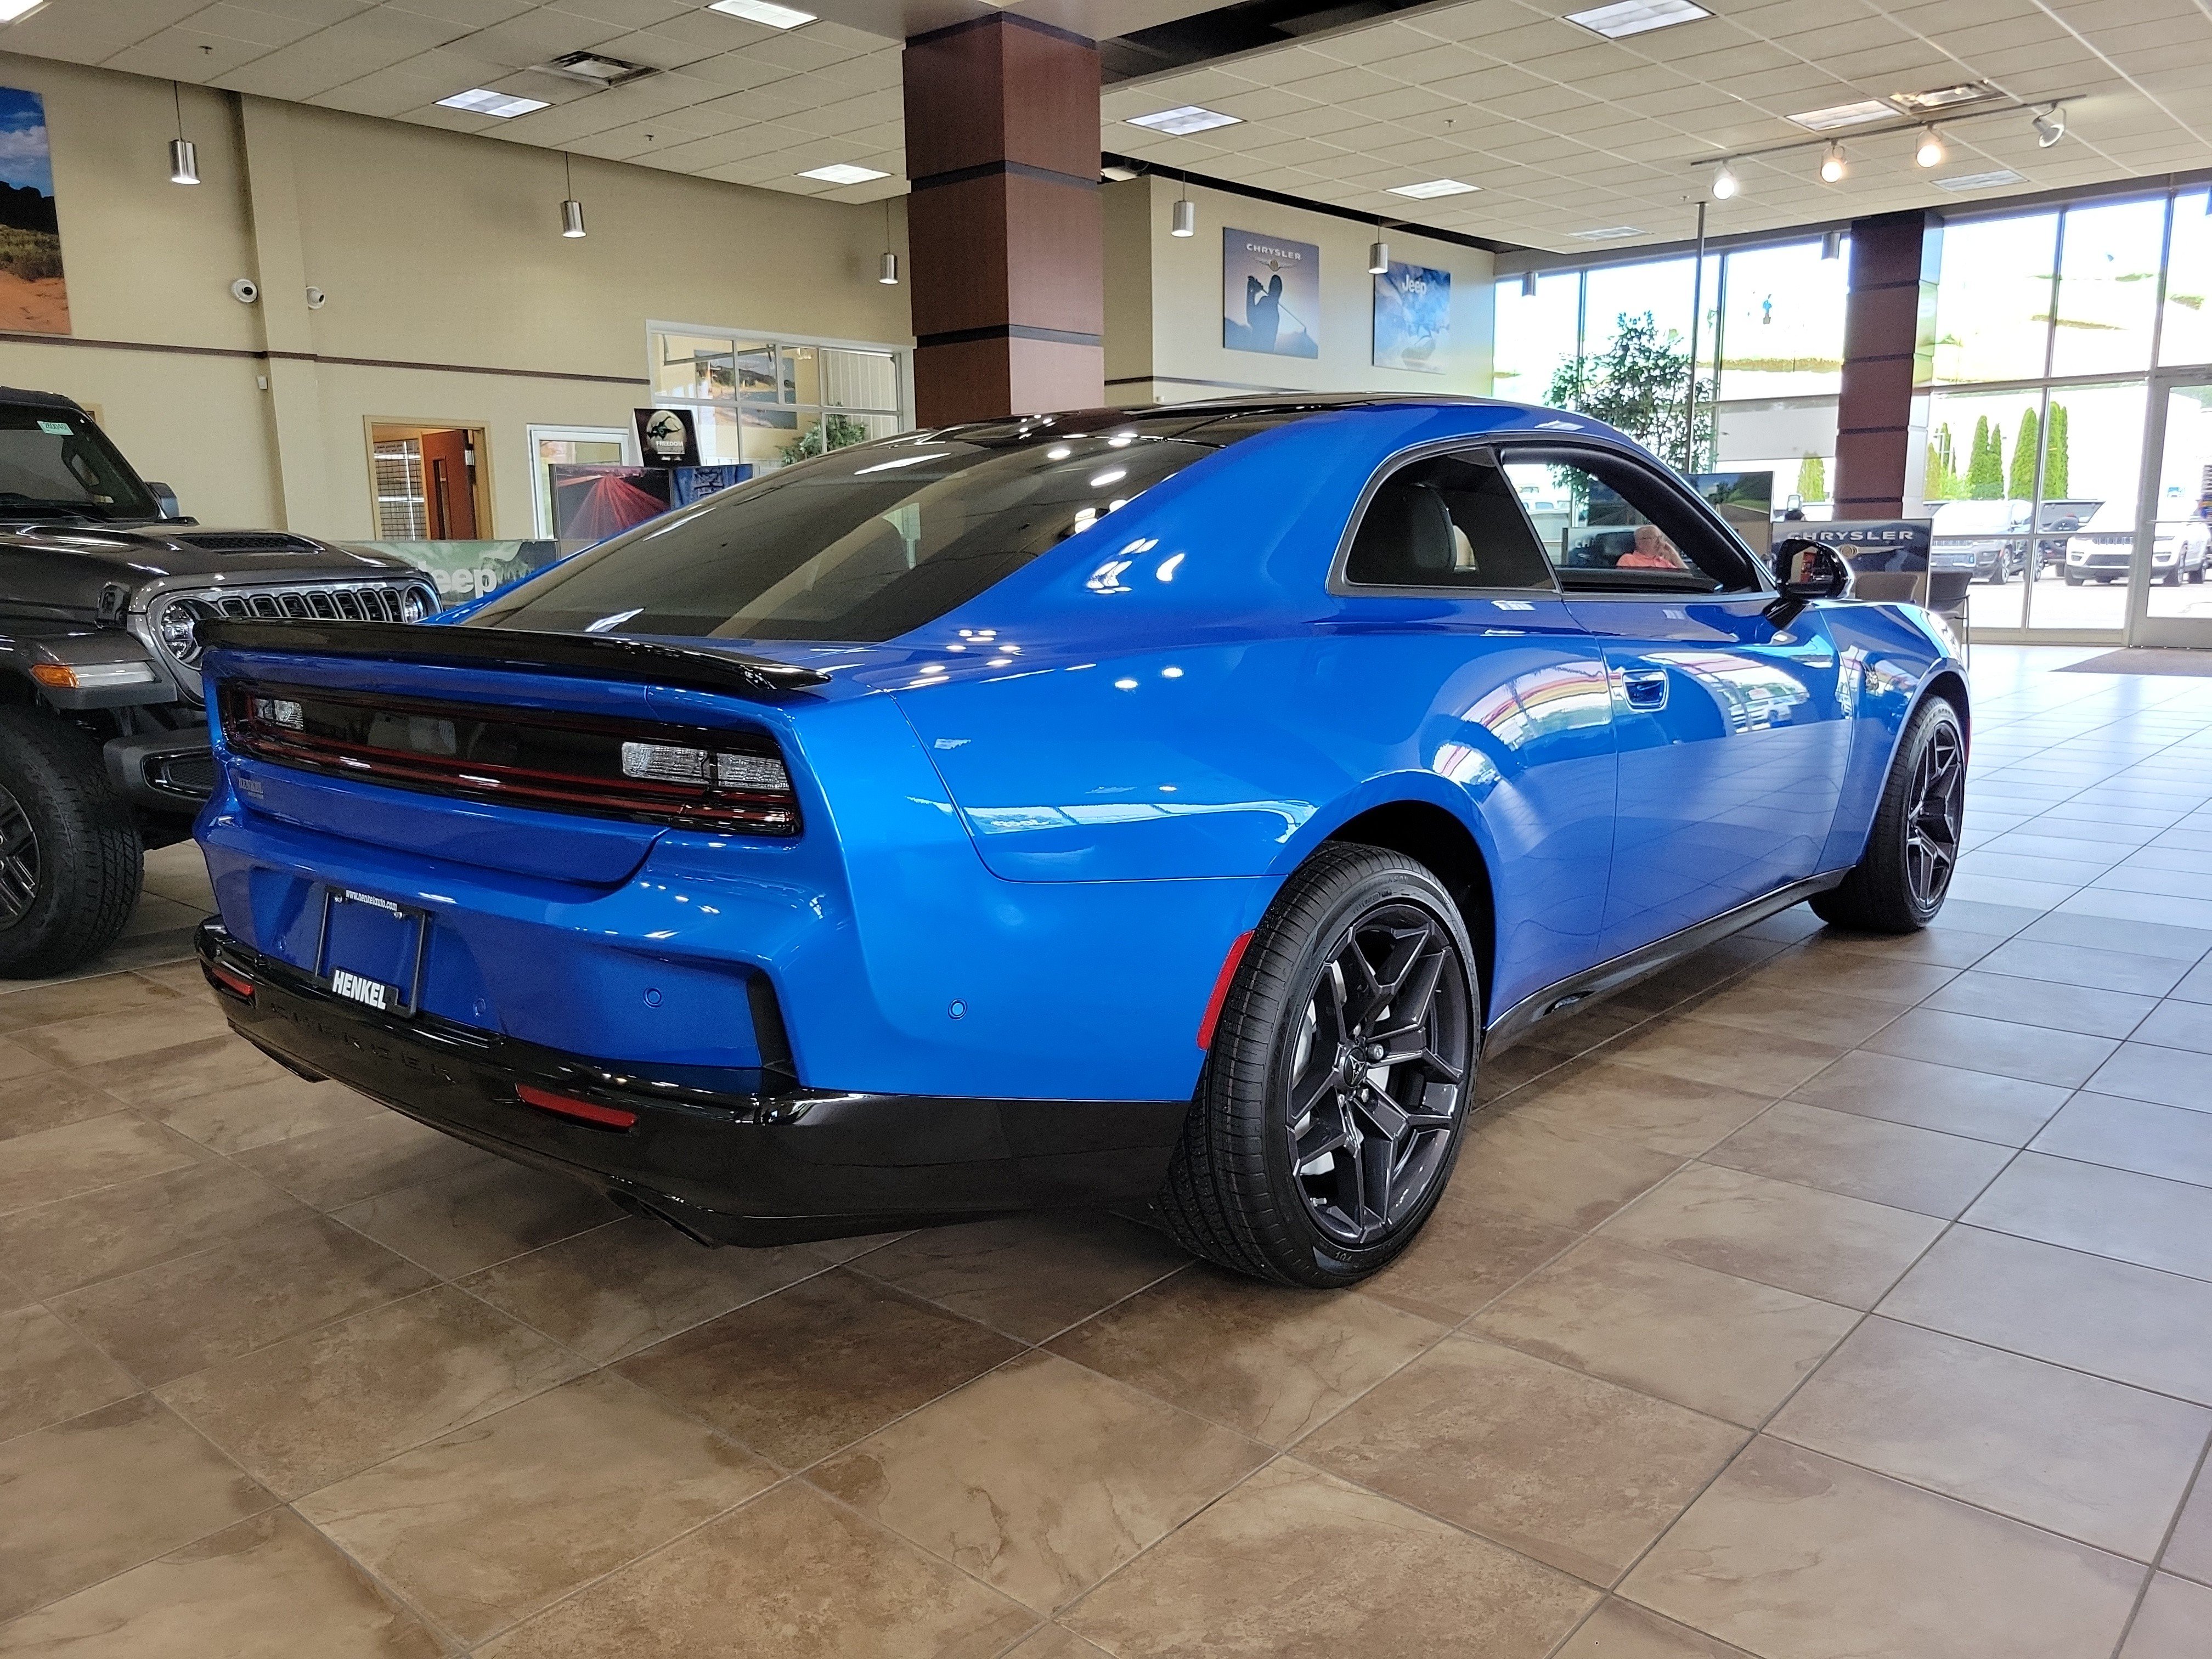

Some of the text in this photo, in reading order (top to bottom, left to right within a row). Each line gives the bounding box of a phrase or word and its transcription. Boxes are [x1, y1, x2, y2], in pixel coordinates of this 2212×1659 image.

[1246, 244, 1301, 261] CHRYSLER
[1402, 274, 1426, 295] Jeep
[1786, 531, 1914, 541] CHRYSLER
[346, 889, 397, 911] www.henkelauto.com
[332, 969, 386, 1010] HENKEL
